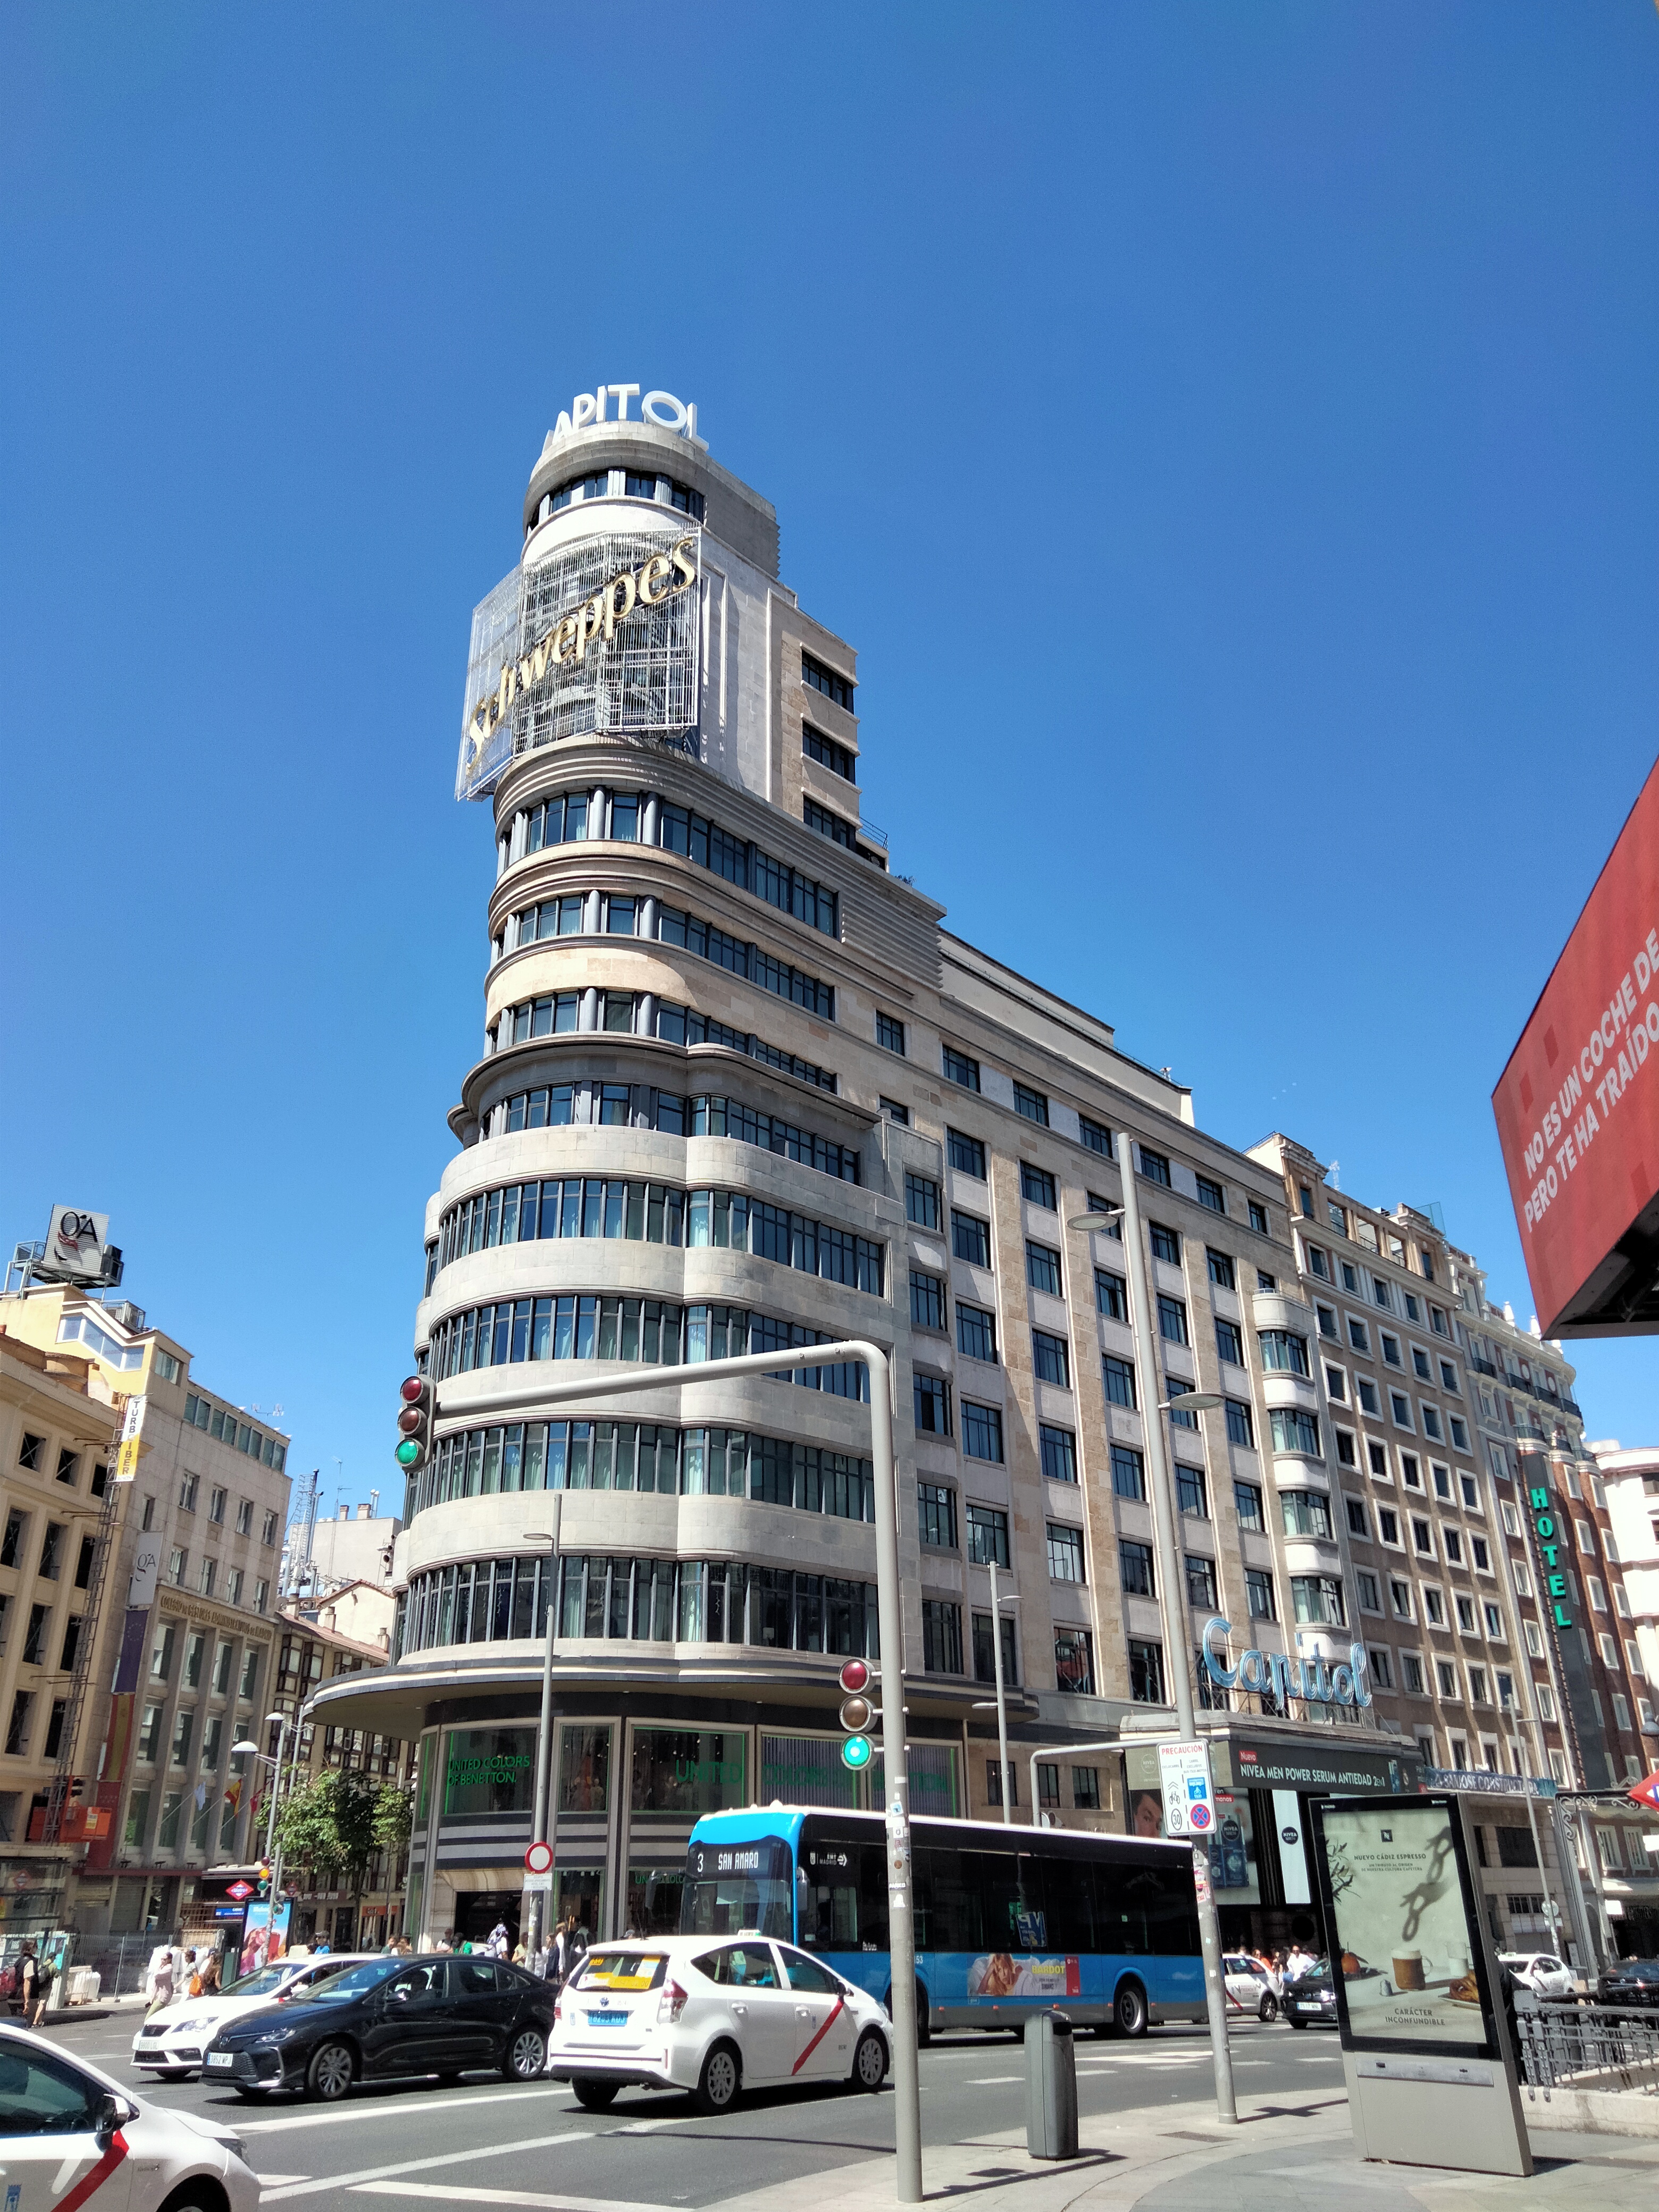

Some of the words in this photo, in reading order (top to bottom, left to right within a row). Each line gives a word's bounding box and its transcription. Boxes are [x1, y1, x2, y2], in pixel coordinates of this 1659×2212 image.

[466, 537, 695, 775] Schweppes
[1523, 1132, 1544, 1179] NO
[1543, 1101, 1562, 1156] ES
[1559, 1065, 1582, 1118] UN
[1580, 973, 1638, 1083] COCHE
[1633, 928, 1659, 994] DE
[1524, 1165, 1559, 1233] PERO
[1556, 1134, 1577, 1181] TE
[1574, 1102, 1600, 1156] HA
[1595, 1002, 1659, 1118] TRAÍDO
[1531, 1487, 1572, 1629] HOTEL
[1203, 1617, 1372, 1711] Capitol
[1162, 1745, 1203, 1756] PRECAUCIÓN
[1241, 1752, 1256, 1762] Nuevo
[449, 1758, 481, 1772] UNITED
[482, 1755, 531, 1770] COLORS
[676, 1759, 742, 1784] UNITED
[448, 1774, 459, 1786] OF
[1240, 1764, 1266, 1779] NIVEA
[1267, 1767, 1284, 1780] MEN
[1285, 1768, 1311, 1782] POWER
[1312, 1770, 1337, 1783] SERUM
[1338, 1772, 1372, 1786] ANTIEDAD
[1478, 1776, 1539, 1795] CONSTRUCTRA
[1173, 1814, 1180, 1825] 30
[697, 1853, 704, 1872] 3
[718, 1854, 733, 1870] SAN
[735, 1851, 759, 1869] AMARO
[666, 1874, 684, 1883] COLO
[1032, 1965, 1066, 1974] BARDOT
[1394, 2007, 1432, 2016] CARÁCTER
[1385, 2016, 1446, 2026] INCONFUNDIBLE
